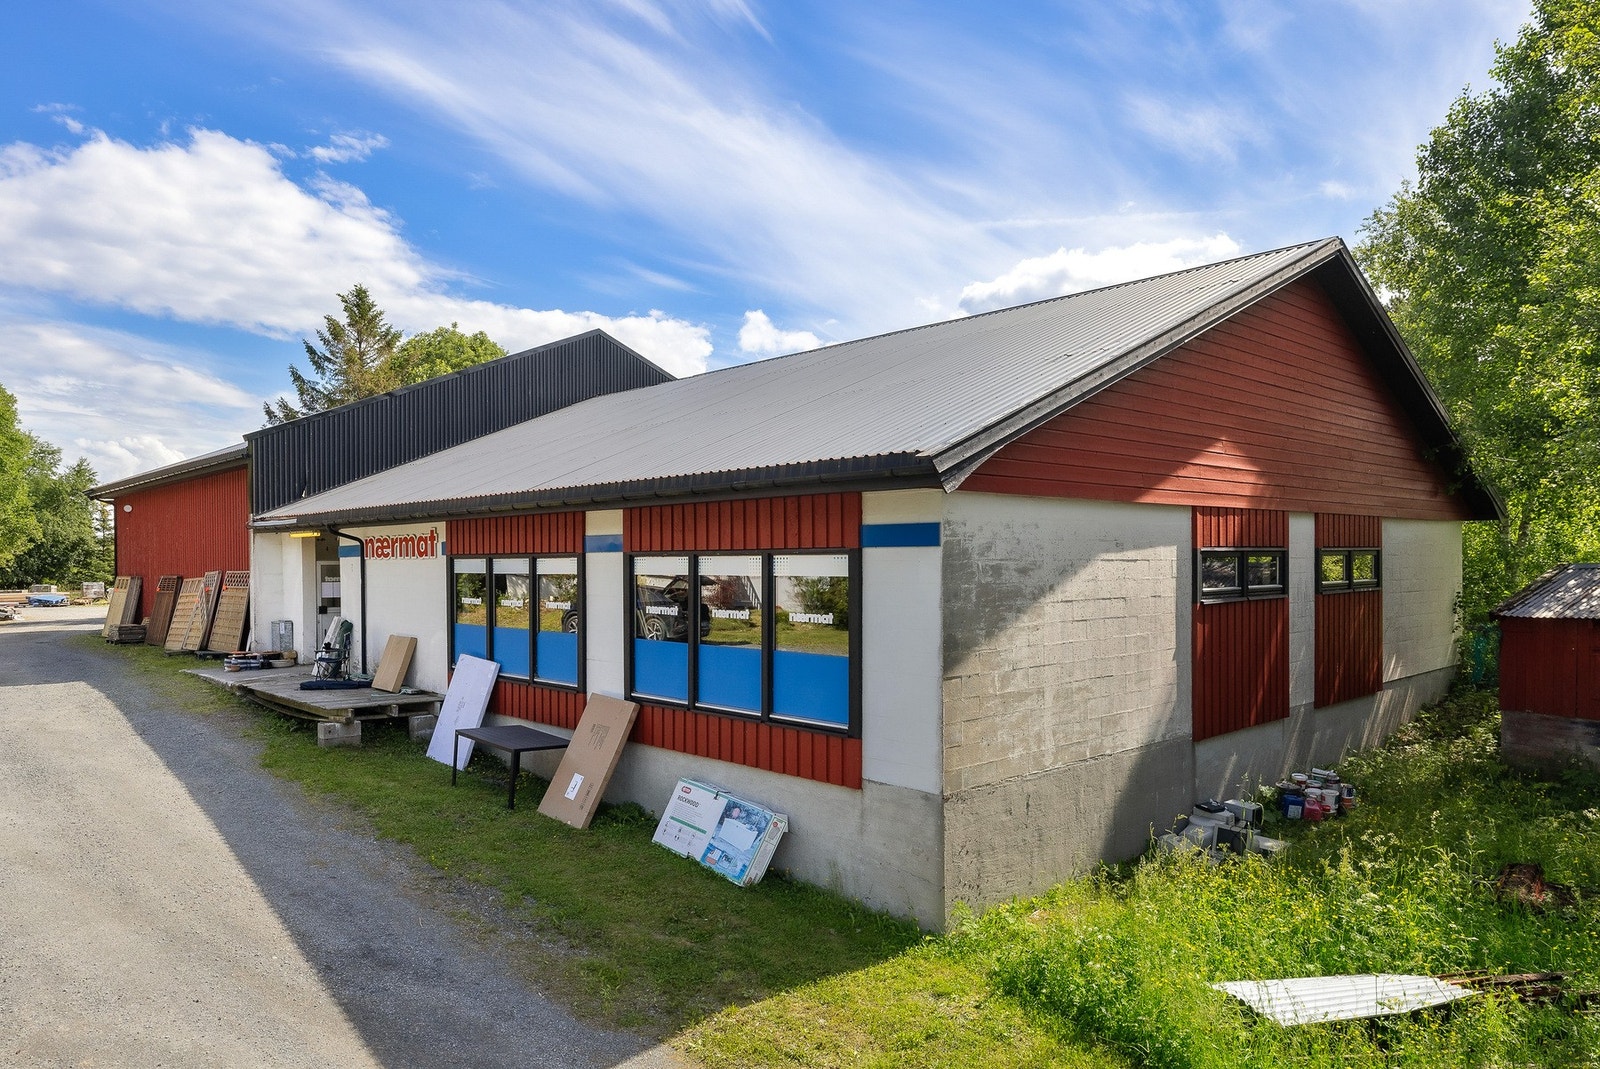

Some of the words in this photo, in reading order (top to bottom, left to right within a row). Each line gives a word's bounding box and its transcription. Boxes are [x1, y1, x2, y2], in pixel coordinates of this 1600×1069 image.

[364, 528, 437, 559] nærmat
[645, 605, 679, 616] nærmat
[712, 608, 750, 620] nærmat
[789, 612, 833, 625] nærmat
